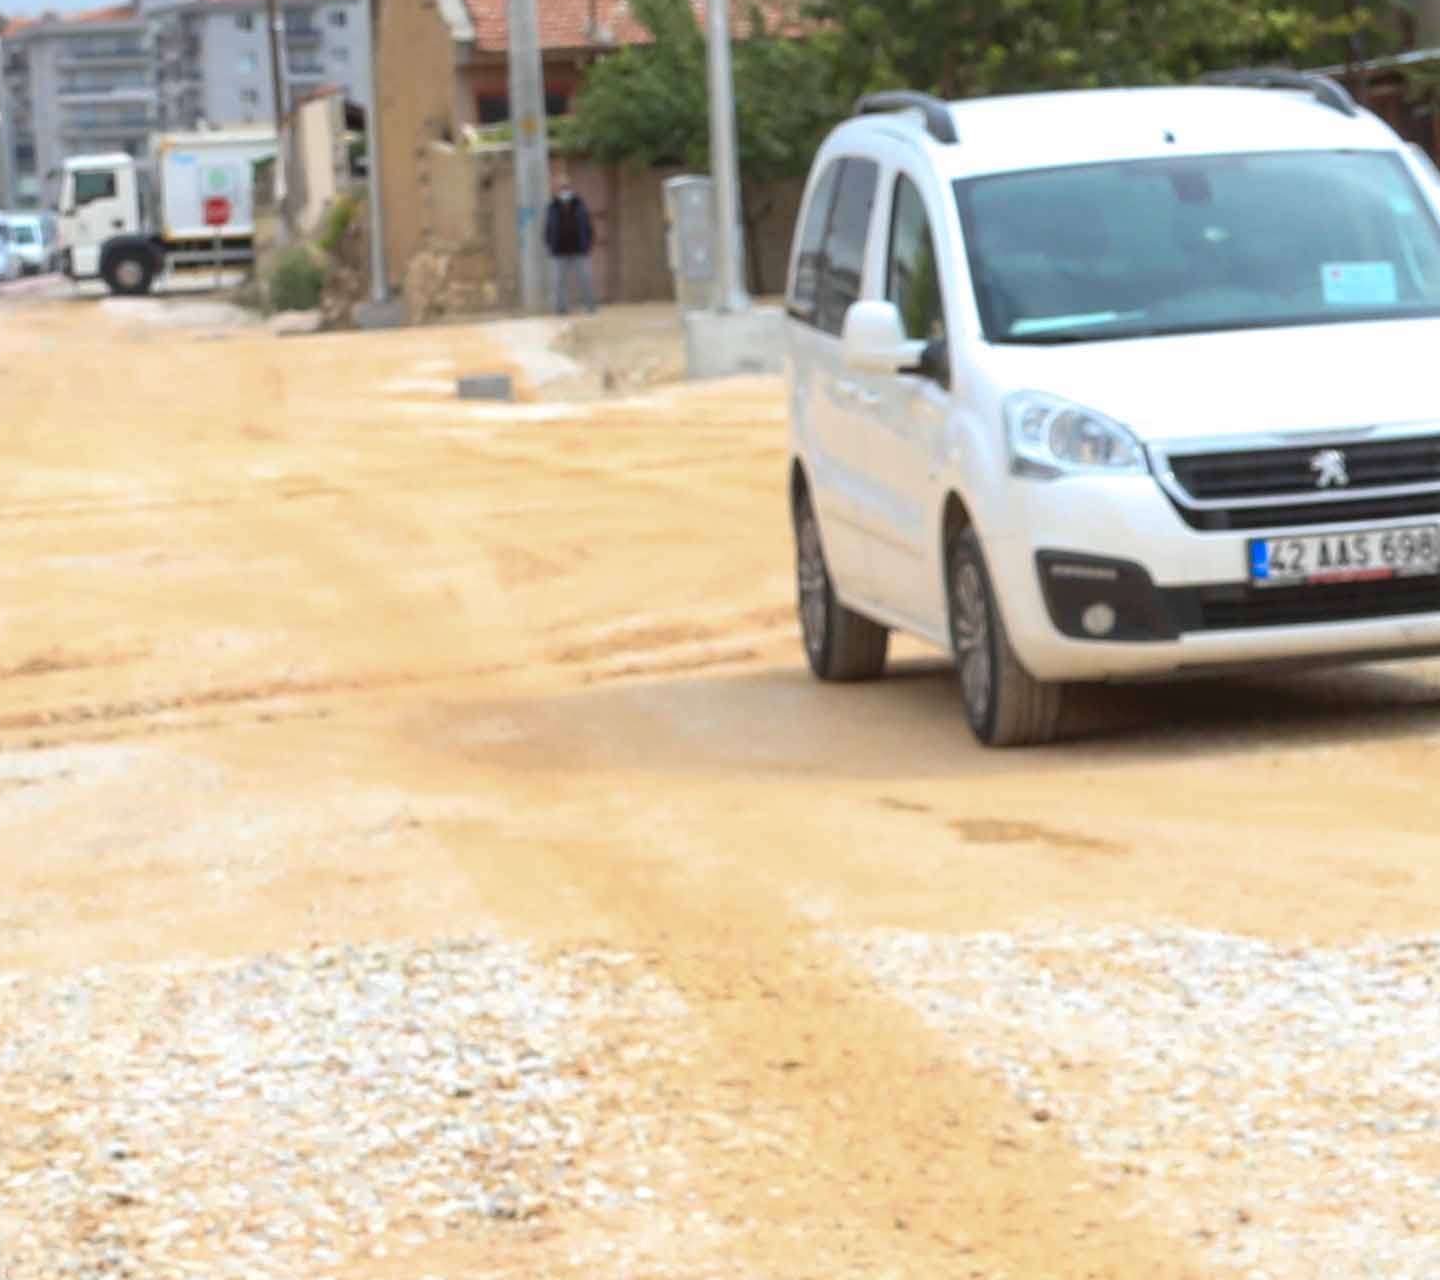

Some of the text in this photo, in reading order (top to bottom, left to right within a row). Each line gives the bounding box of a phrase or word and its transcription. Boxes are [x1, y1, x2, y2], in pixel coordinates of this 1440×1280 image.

[1270, 531, 1433, 570] 42 AAS 698
